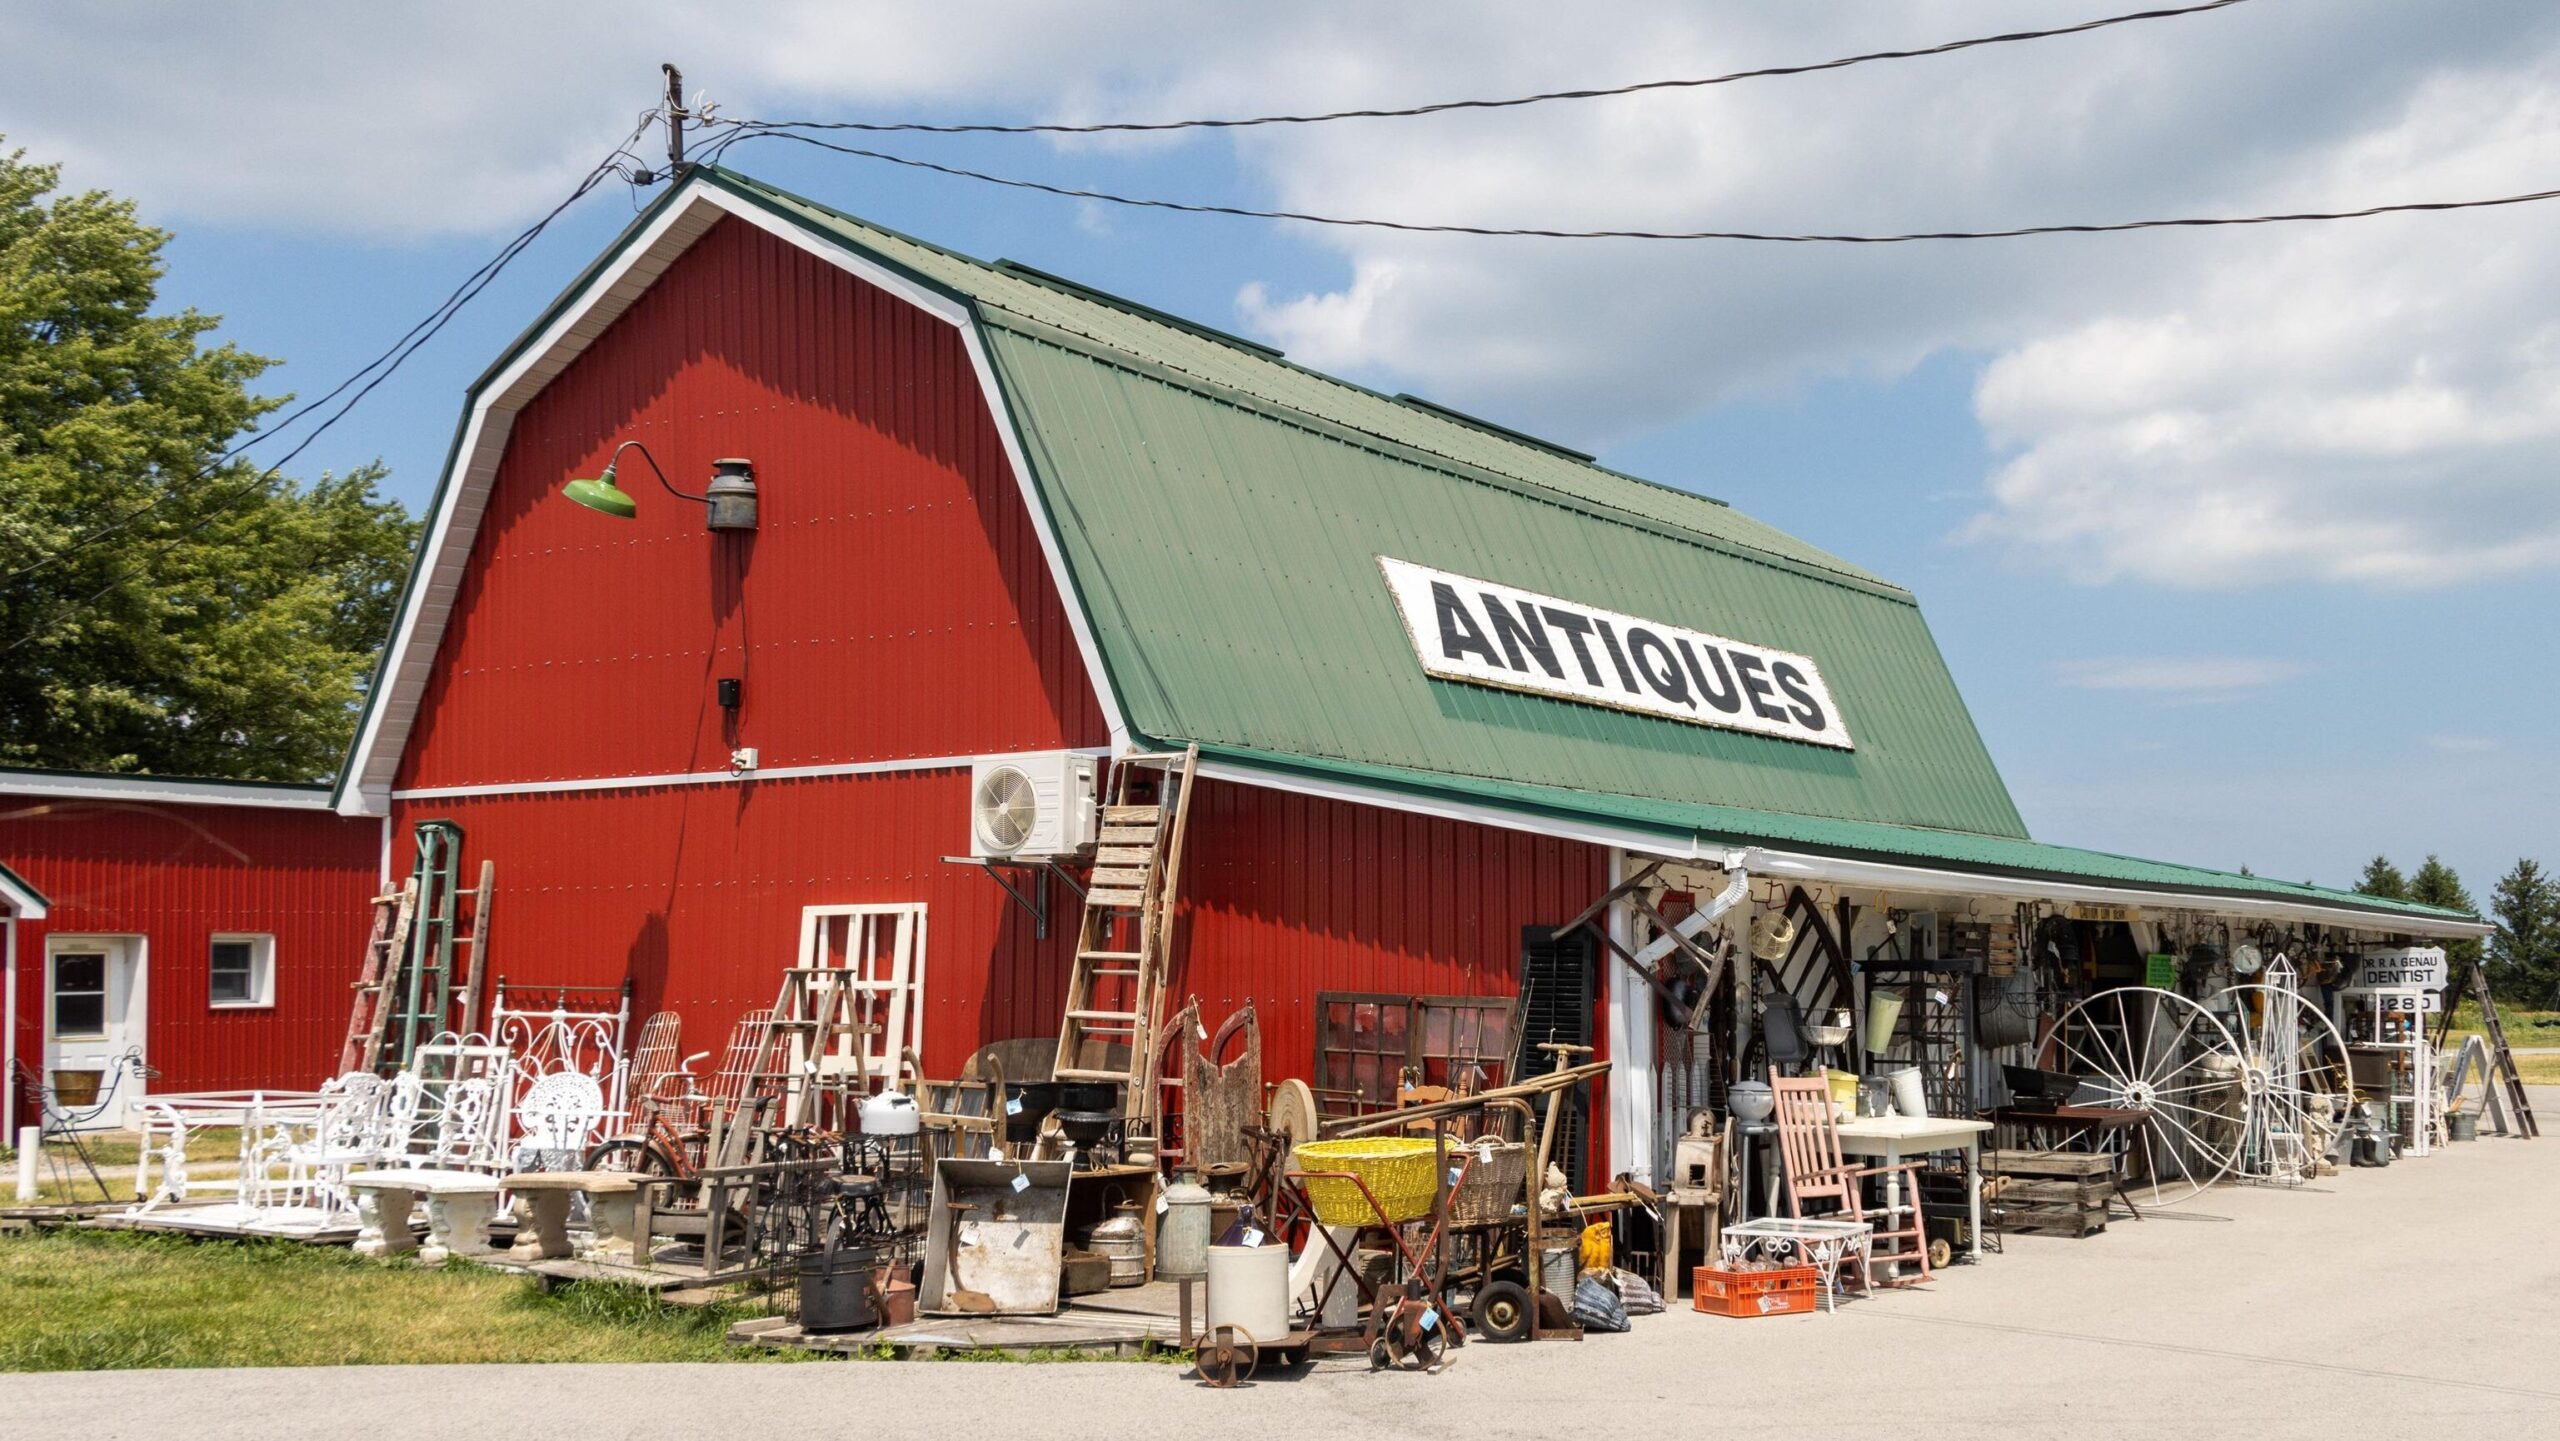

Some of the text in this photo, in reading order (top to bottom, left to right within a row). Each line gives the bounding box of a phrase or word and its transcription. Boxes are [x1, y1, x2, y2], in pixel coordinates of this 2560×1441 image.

[1430, 580, 1826, 732] ANTIQUES
[2401, 957, 2437, 967] GENAU
[2368, 970, 2434, 983] DENTIST
